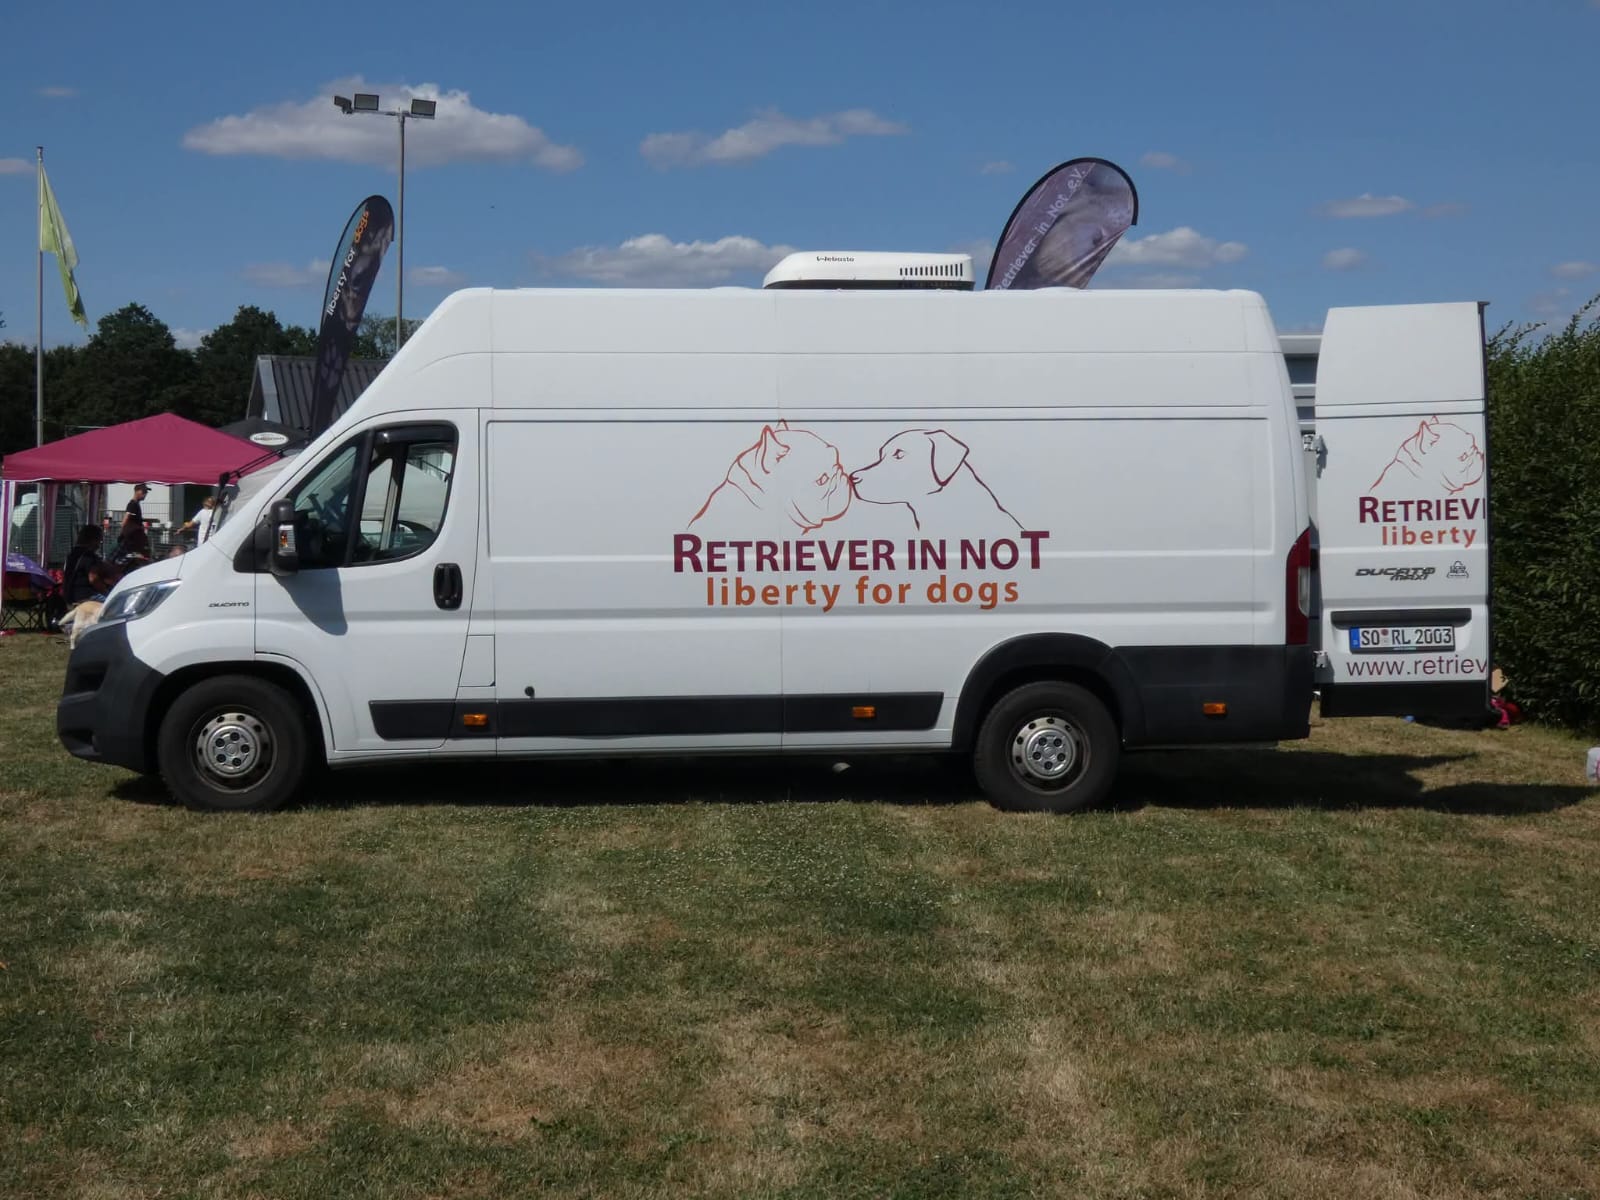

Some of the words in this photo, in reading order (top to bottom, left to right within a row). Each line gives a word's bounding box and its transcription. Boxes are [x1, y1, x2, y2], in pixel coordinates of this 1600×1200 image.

[1034, 222, 1050, 235] in
[1047, 194, 1069, 217] Not
[326, 271, 348, 316] liberty
[344, 247, 356, 268] for
[354, 210, 369, 244] dogs
[673, 533, 896, 573] RETRIEVER
[907, 539, 947, 571] IN
[959, 530, 1050, 570] NOT
[1382, 525, 1476, 548] liberty
[1355, 567, 1436, 576] DUCATO
[706, 577, 841, 613] liberty
[855, 575, 912, 604] for
[926, 575, 1019, 610] dogs
[1361, 630, 1380, 646] SO
[1391, 629, 1411, 645] RL
[1415, 628, 1452, 645] 2003
[1346, 655, 1487, 676] www.retriev
